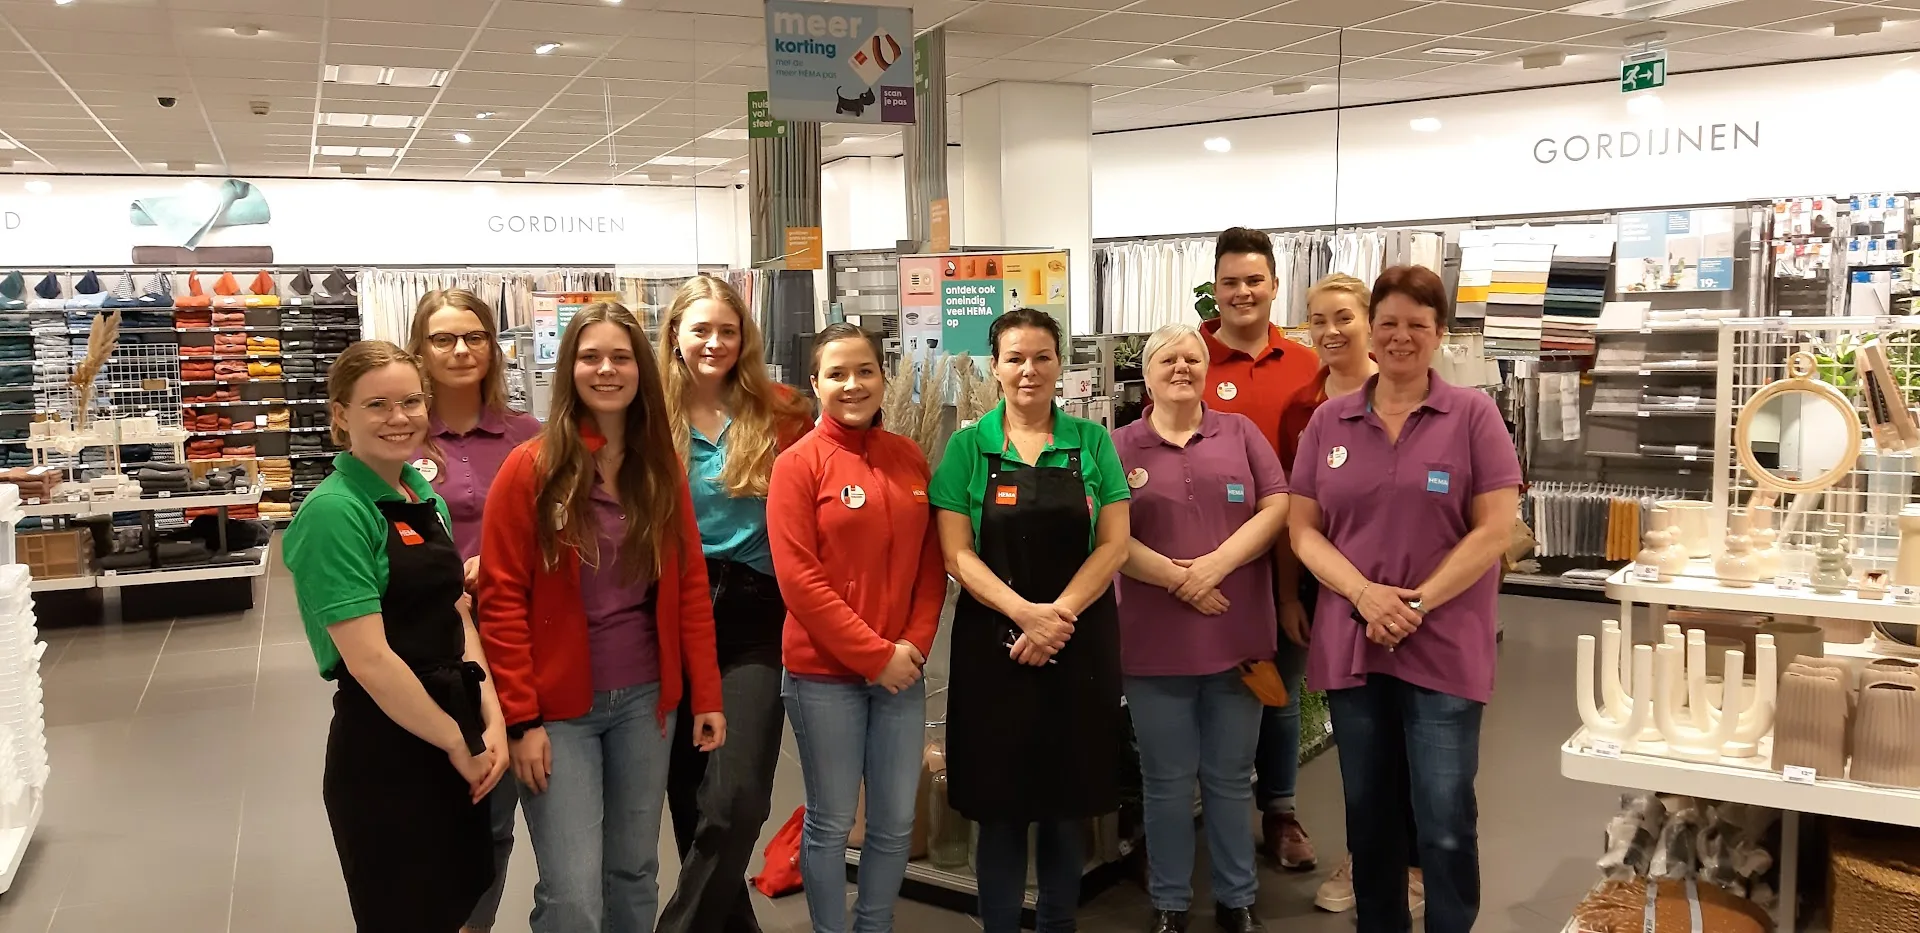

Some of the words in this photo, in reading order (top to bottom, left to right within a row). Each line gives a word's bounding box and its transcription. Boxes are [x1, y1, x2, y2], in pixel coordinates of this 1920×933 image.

[773, 11, 863, 39] meer
[775, 38, 836, 58] korting
[776, 69, 798, 77] meer
[799, 69, 822, 79] HEMA
[822, 71, 837, 80] pas
[884, 89, 902, 97] scan
[752, 99, 769, 109] huis
[884, 97, 892, 107] je
[893, 98, 908, 107] pas
[752, 109, 766, 118] vol
[1533, 121, 1760, 164] GORDIJNEN
[488, 215, 625, 233] GORDIJNEN
[945, 285, 977, 295] ontdek
[978, 285, 996, 294] ook
[946, 295, 986, 306] oneindig
[946, 307, 965, 316] veel
[966, 307, 993, 316] HEMA
[946, 318, 959, 328] op
[1428, 477, 1449, 486] HEMA
